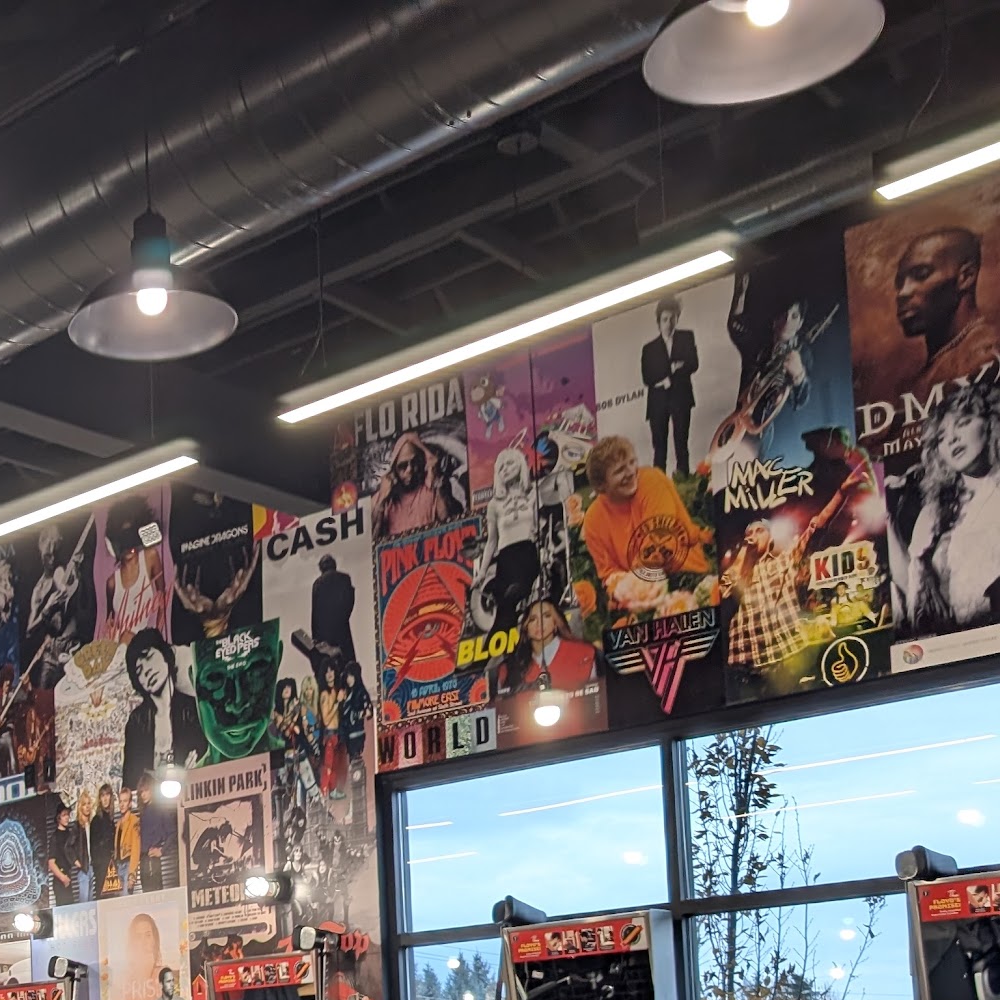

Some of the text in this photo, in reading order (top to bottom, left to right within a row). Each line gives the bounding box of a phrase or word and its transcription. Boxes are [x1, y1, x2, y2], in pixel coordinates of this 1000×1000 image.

[353, 377, 464, 448] FLO RIDA
[615, 389, 645, 407] DYLAN
[730, 456, 784, 489] MAC
[180, 525, 249, 553] IMAGINE DRAGONS
[267, 507, 365, 562] CASH
[380, 542, 419, 598] PINK
[814, 546, 871, 583] KIDS
[221, 630, 252, 648] BLACK
[610, 608, 716, 651] VAN HALEN
[456, 627, 521, 667] BLON
[440, 690, 460, 703] EAST
[379, 715, 490, 765] WORLD
[186, 768, 264, 802] LINKIN PARK
[191, 883, 246, 909] METEO
[122, 976, 158, 1000] PRIS
